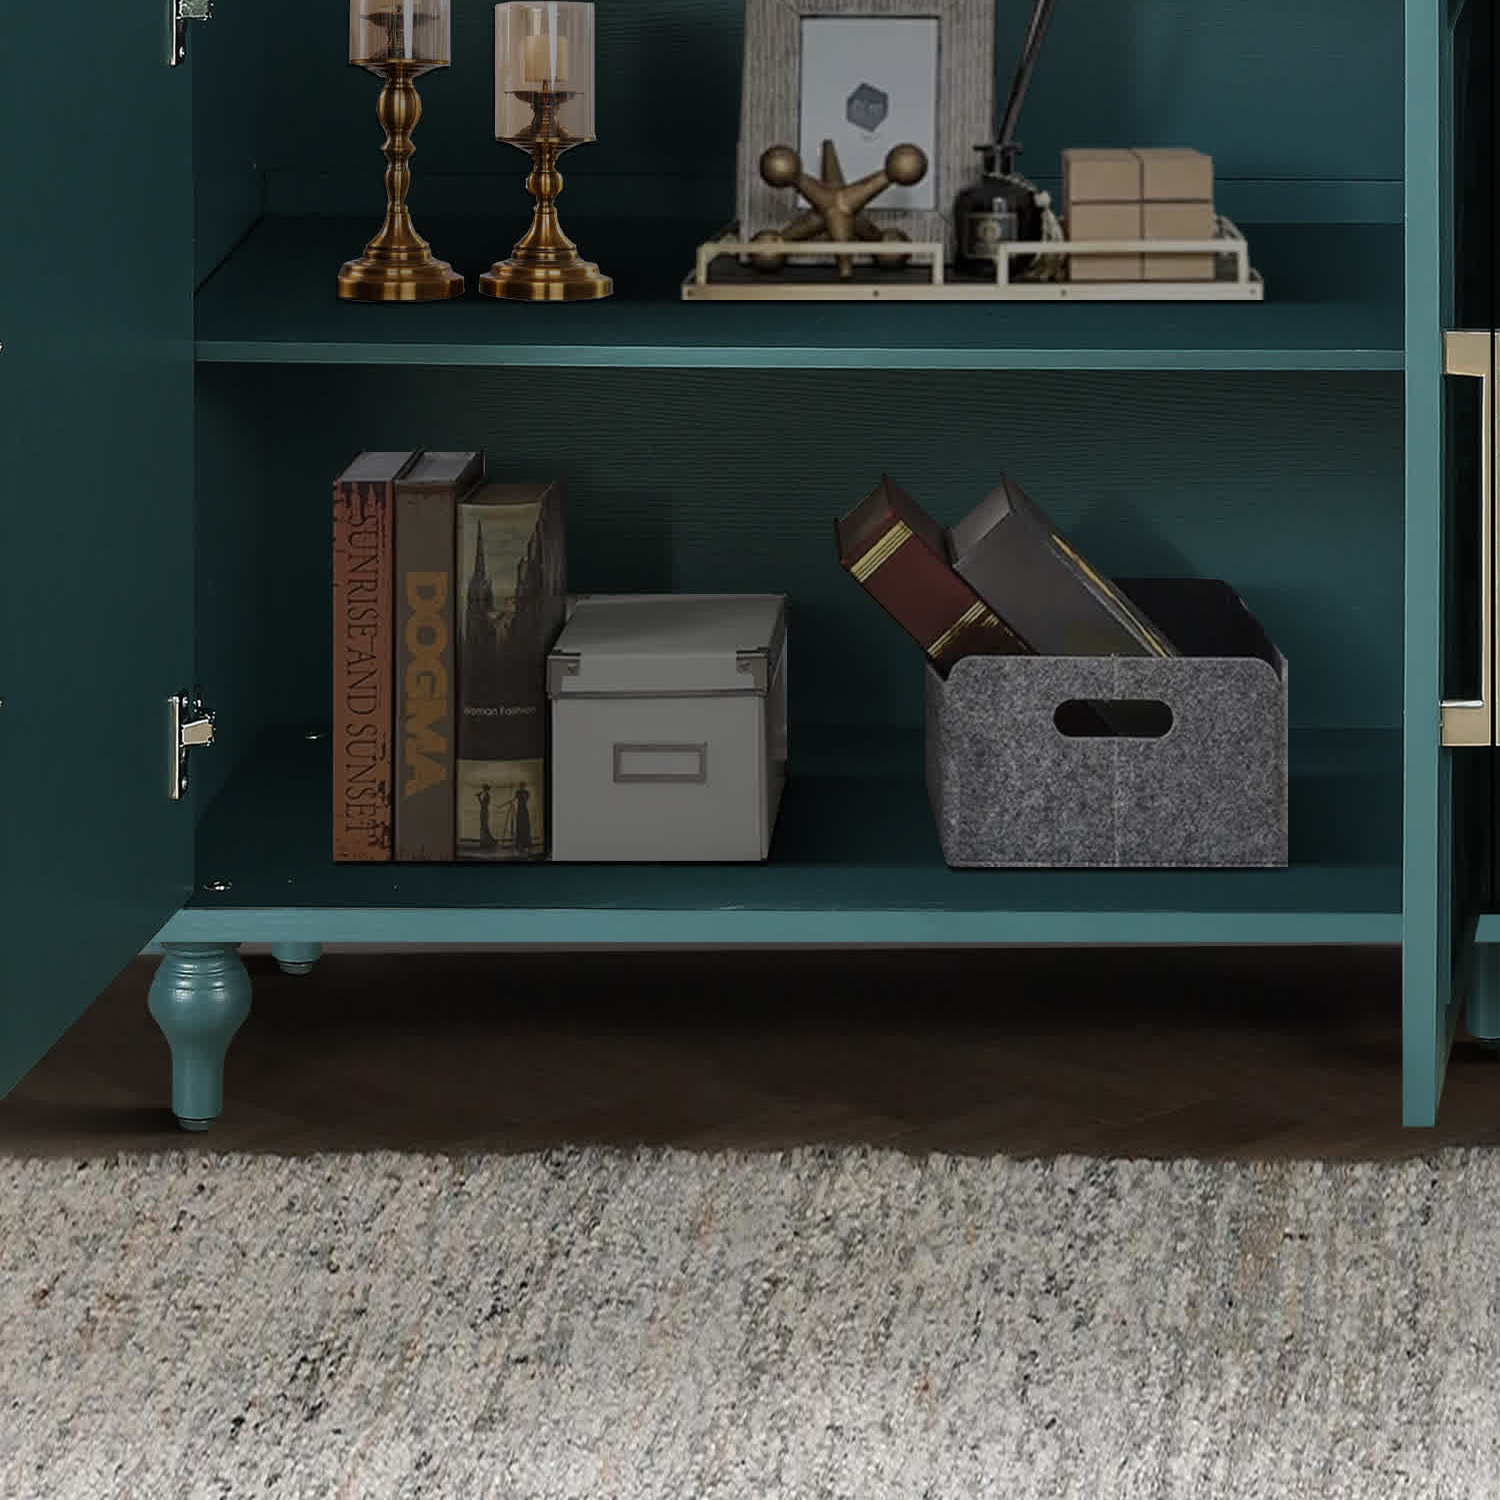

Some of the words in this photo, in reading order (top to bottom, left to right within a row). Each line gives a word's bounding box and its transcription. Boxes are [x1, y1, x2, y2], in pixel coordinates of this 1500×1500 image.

[346, 508, 380, 639] SUNRISE
[346, 646, 378, 715] AND
[405, 572, 449, 797] DOGMA
[344, 723, 379, 833] SUNSET
